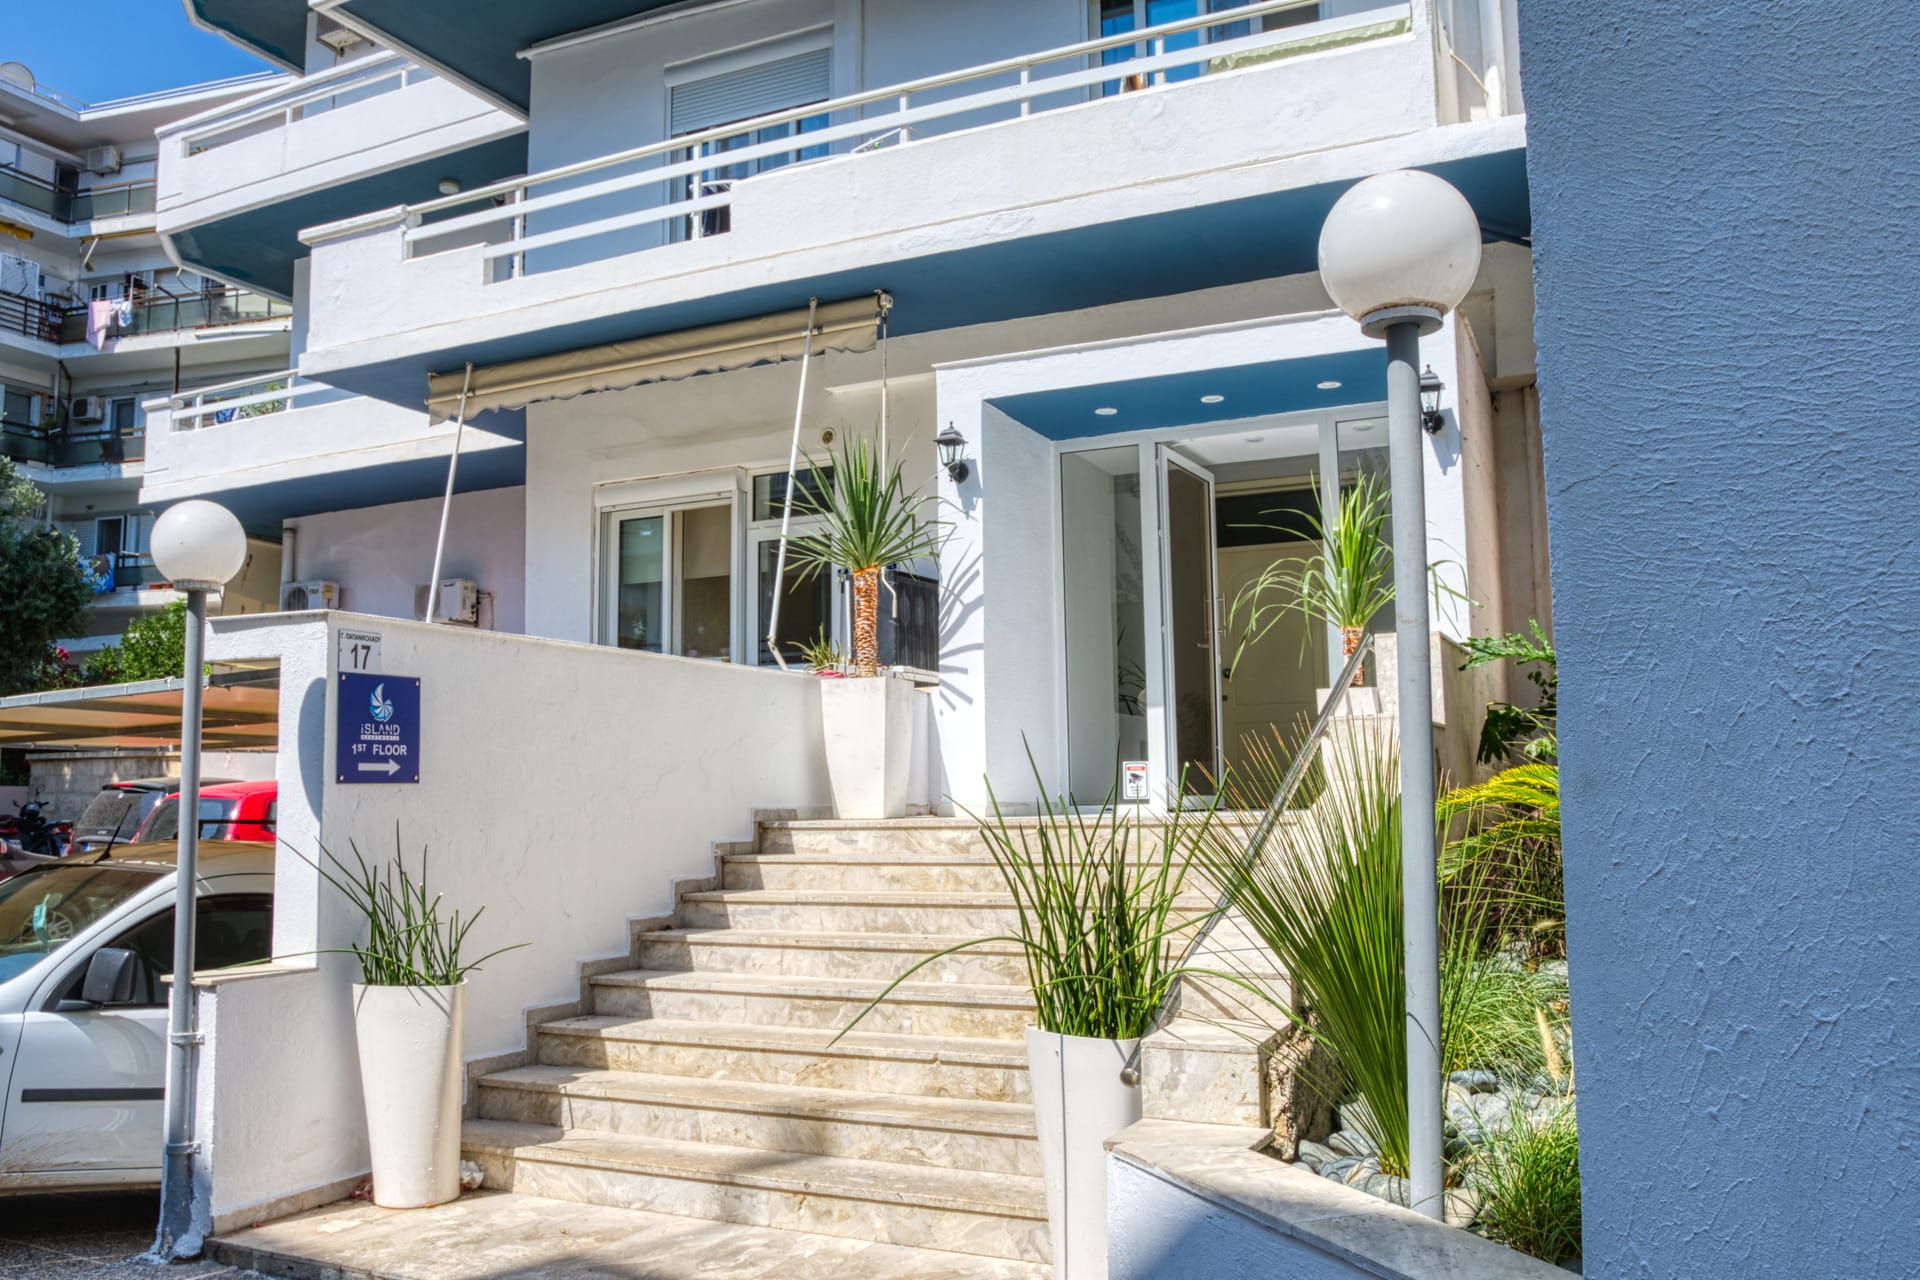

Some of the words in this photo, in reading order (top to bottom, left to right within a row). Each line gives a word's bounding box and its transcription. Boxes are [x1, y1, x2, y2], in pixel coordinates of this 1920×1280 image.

[351, 643, 371, 670] 17
[352, 743, 367, 755] 1ST
[373, 744, 407, 756] FLOOR
